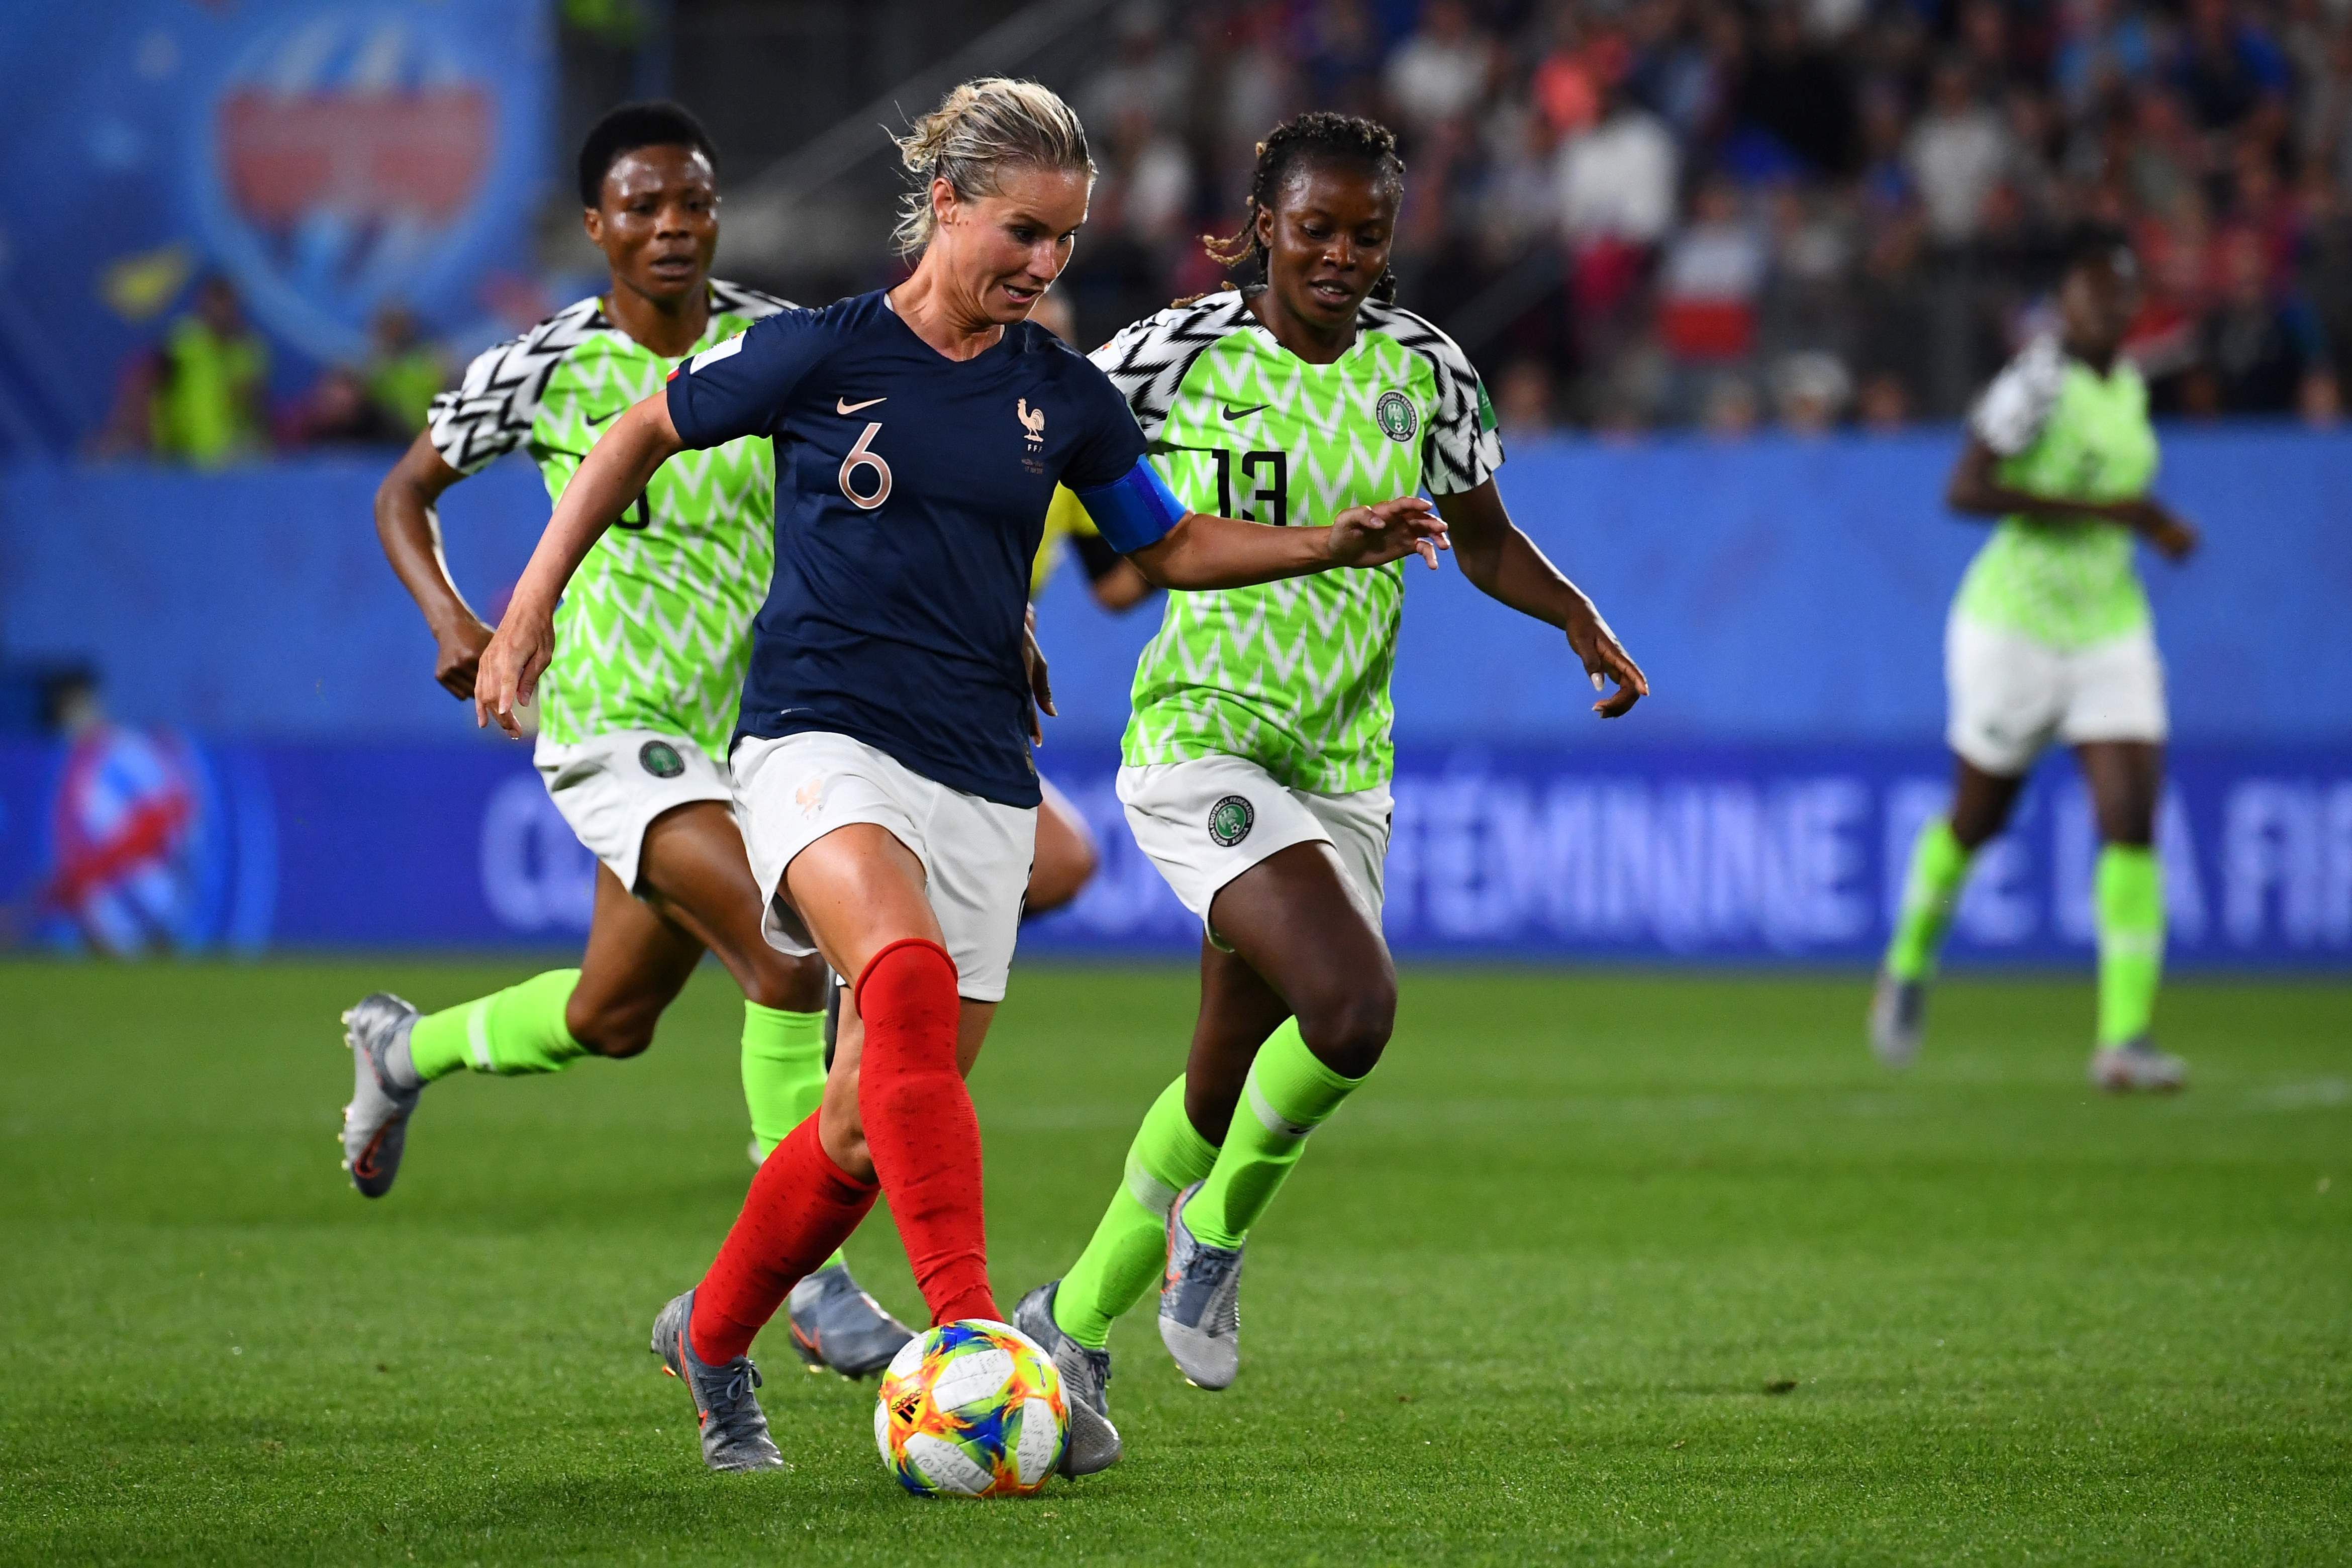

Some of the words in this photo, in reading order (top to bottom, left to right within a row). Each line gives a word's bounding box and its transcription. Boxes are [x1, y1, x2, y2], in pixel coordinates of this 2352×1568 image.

[839, 423, 892, 510] 6
[1211, 448, 1287, 526] 13
[1209, 799, 1230, 828] FOOTBALL
[1230, 797, 1253, 823] FEDERATION
[891, 1388, 923, 1413] adidas
